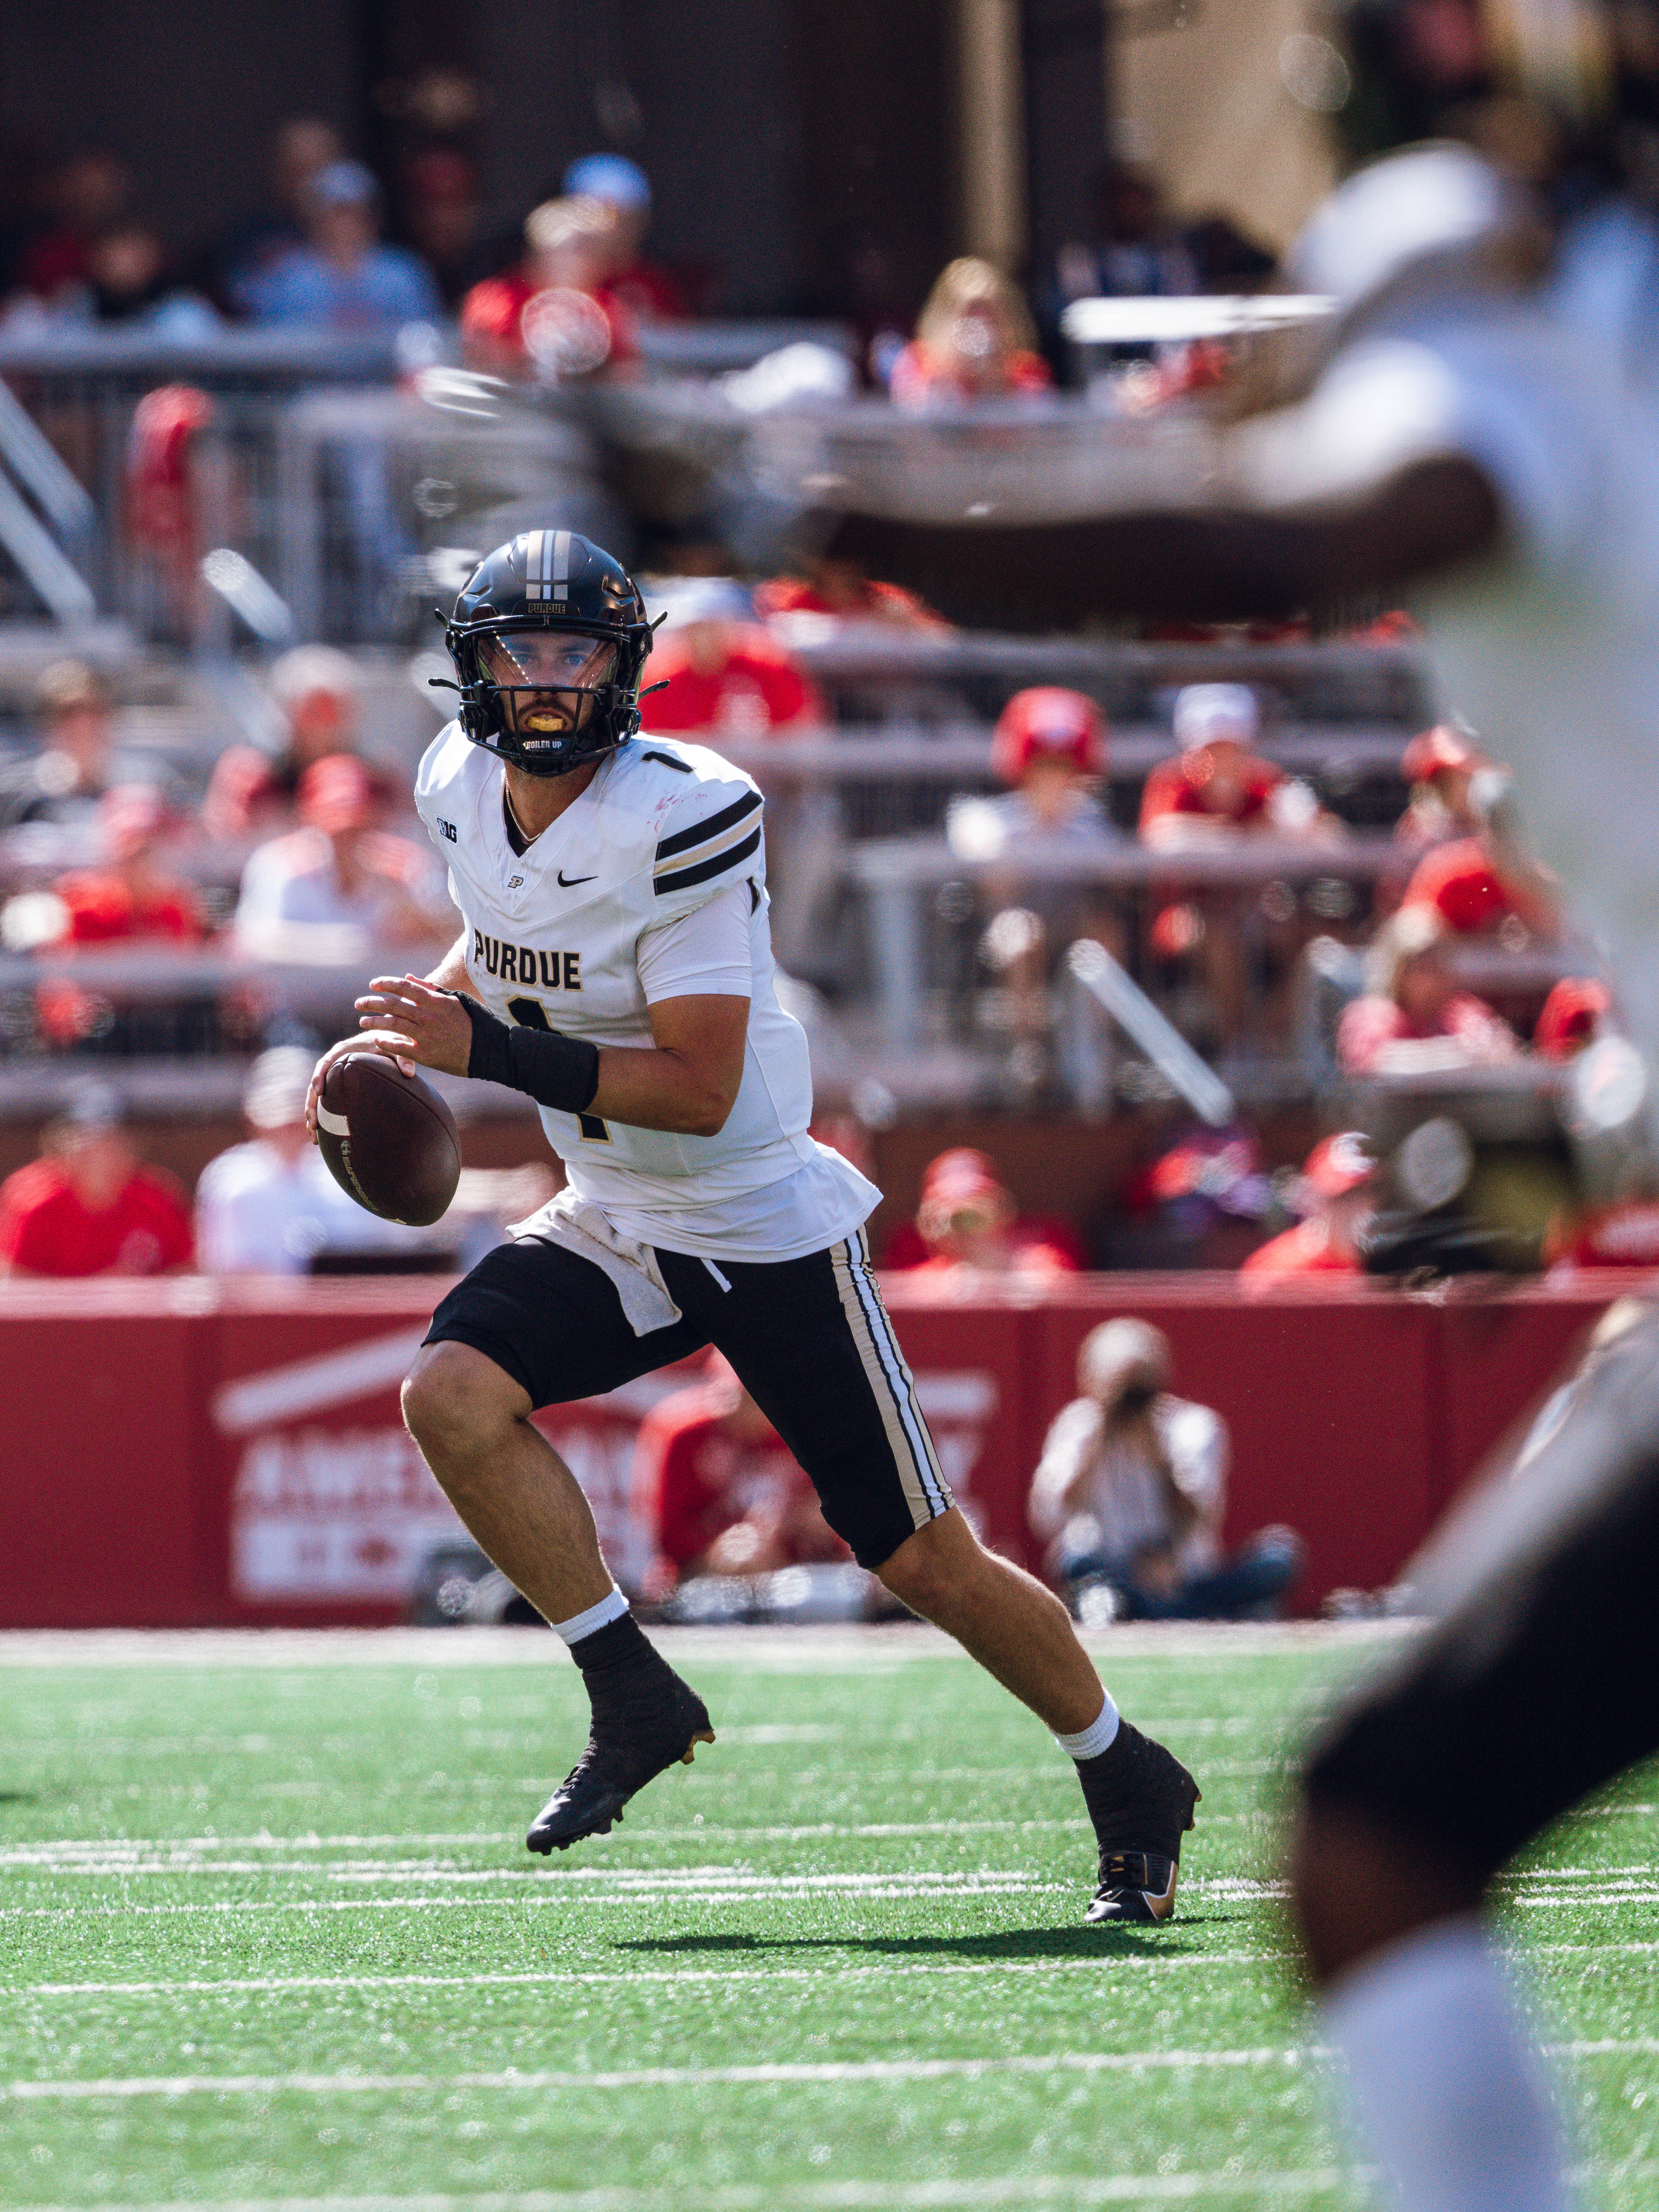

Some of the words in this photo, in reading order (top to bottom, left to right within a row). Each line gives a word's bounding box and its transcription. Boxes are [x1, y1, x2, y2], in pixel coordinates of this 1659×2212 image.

[528, 603, 565, 614] PURDUE
[526, 740, 550, 749] BOILER
[552, 740, 562, 749] UP
[474, 928, 584, 992] PURDUE
[342, 1157, 360, 1187] ELITE
